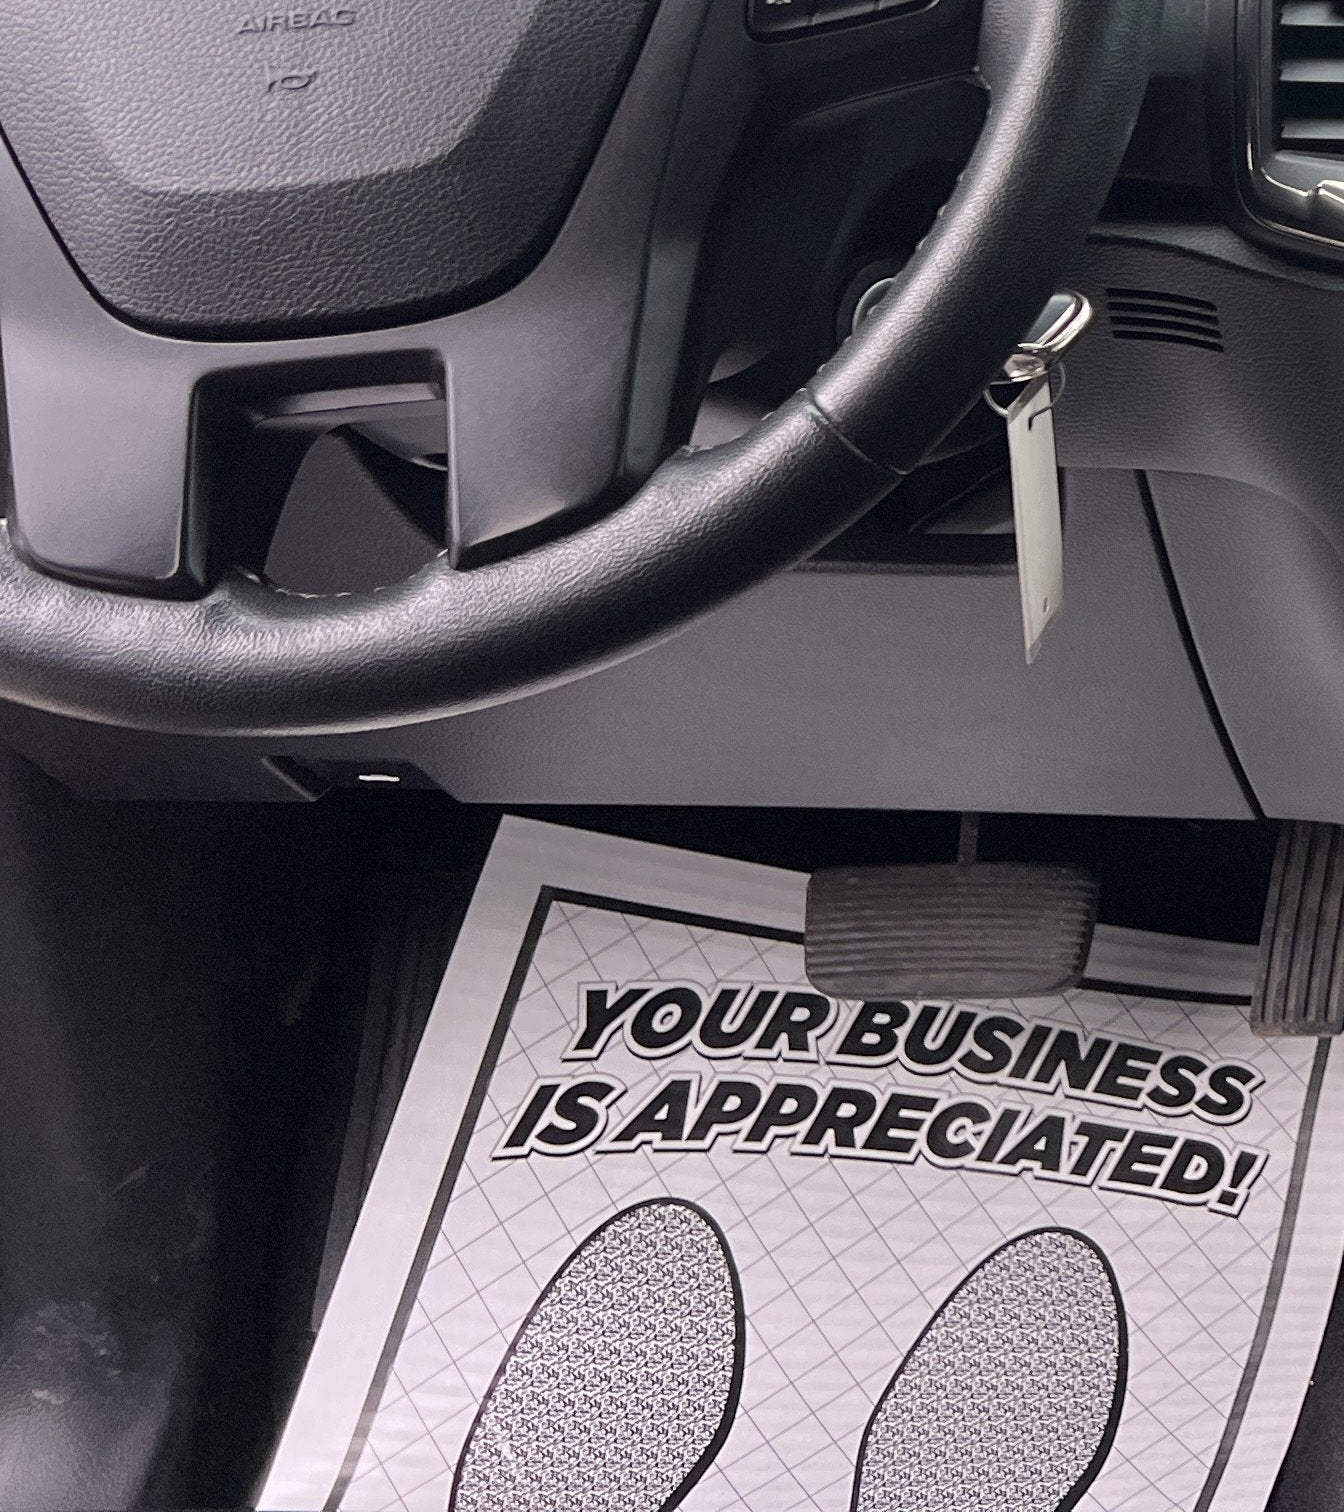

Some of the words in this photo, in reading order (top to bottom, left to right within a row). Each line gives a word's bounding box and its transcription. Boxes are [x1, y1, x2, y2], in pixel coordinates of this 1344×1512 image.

[237, 9, 357, 35] AIRBAG
[567, 986, 826, 1061] YOUR
[843, 999, 1262, 1122] BUSINESS
[504, 1083, 620, 1152] IS
[612, 1080, 1268, 1215] APPRECIATED!
